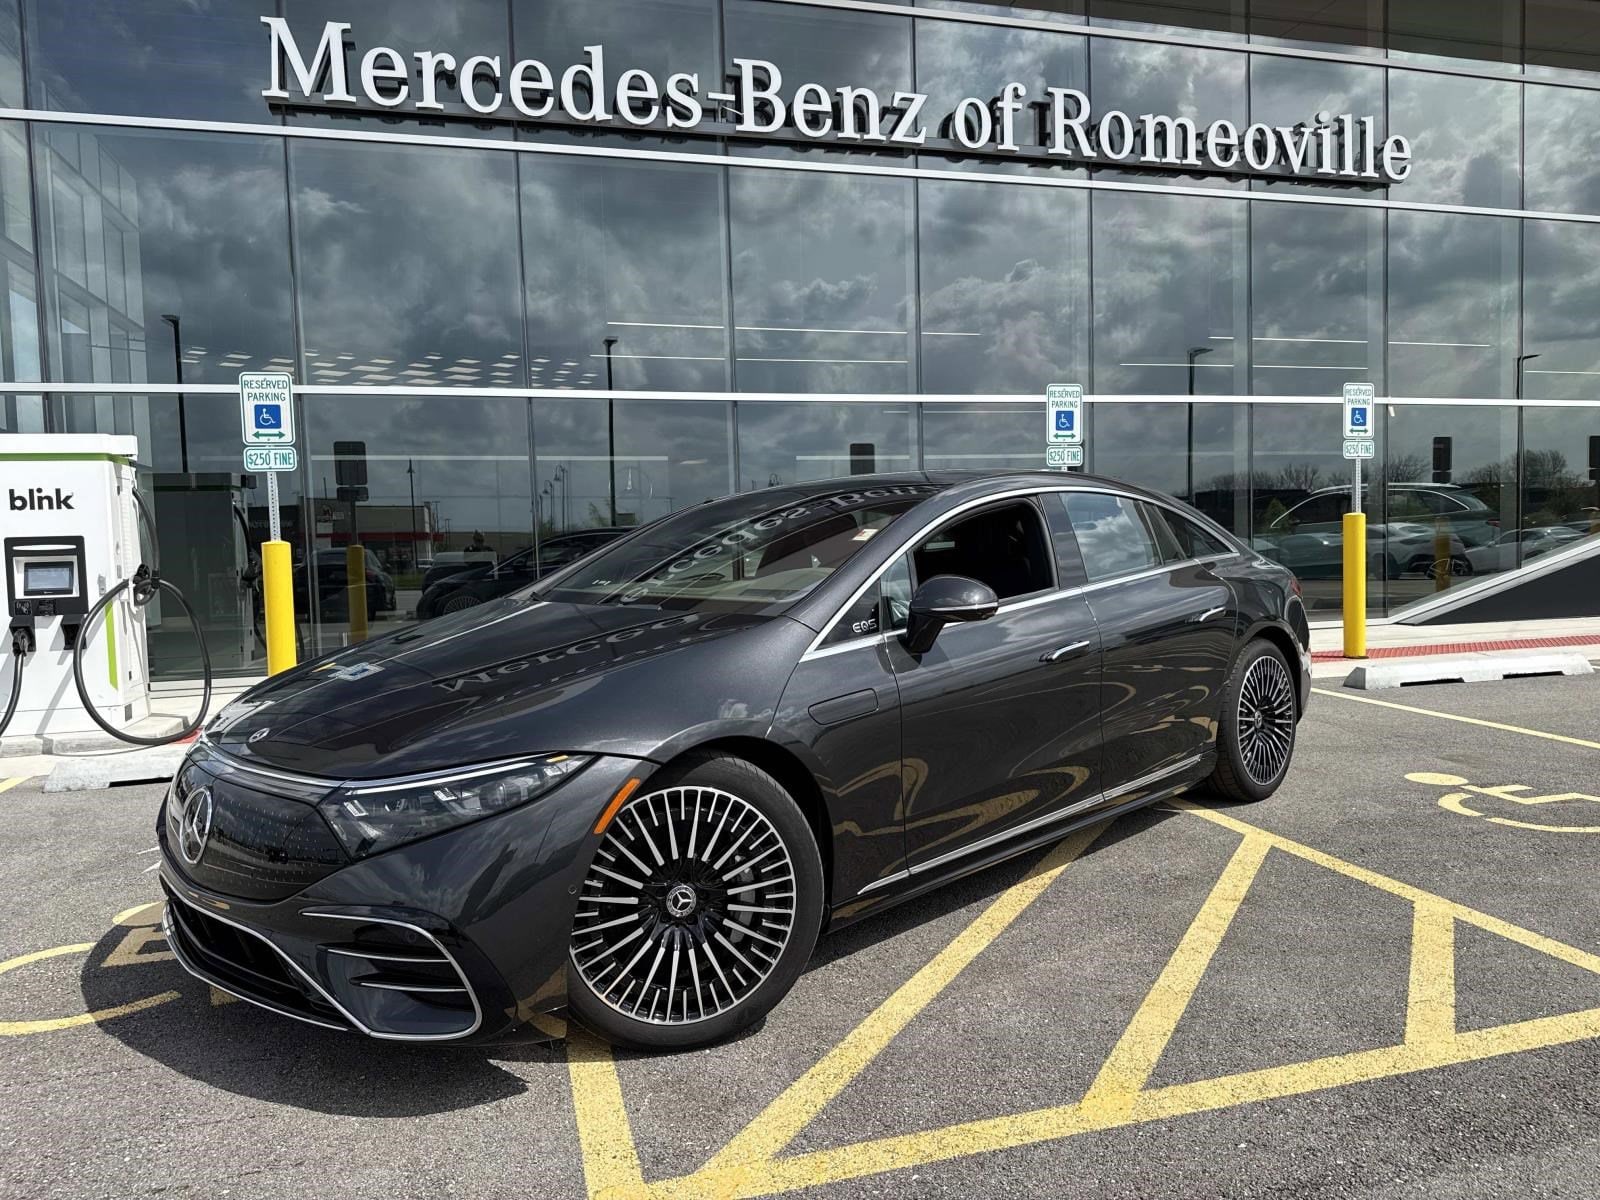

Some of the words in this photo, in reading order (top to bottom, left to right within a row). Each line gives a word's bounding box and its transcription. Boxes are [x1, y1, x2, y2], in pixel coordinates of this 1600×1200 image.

[260, 15, 928, 144] Mercedes-Benz
[953, 81, 1027, 152] of
[1046, 86, 1414, 184] Romeoville
[243, 379, 288, 390] RESERVED
[247, 392, 286, 402] PARKING
[1049, 390, 1080, 399] RESERVED
[1345, 388, 1372, 397] RESERVED
[1051, 400, 1078, 409] PARKING
[1347, 398, 1371, 406] PARKING
[1345, 444, 1359, 455] $250
[1360, 444, 1372, 455] FINE
[247, 452, 271, 466] $250
[274, 452, 293, 466] FINE
[1049, 450, 1065, 462] $250
[1066, 450, 1080, 462] FINE
[8, 487, 75, 511] blink
[852, 618, 877, 633] EQS
